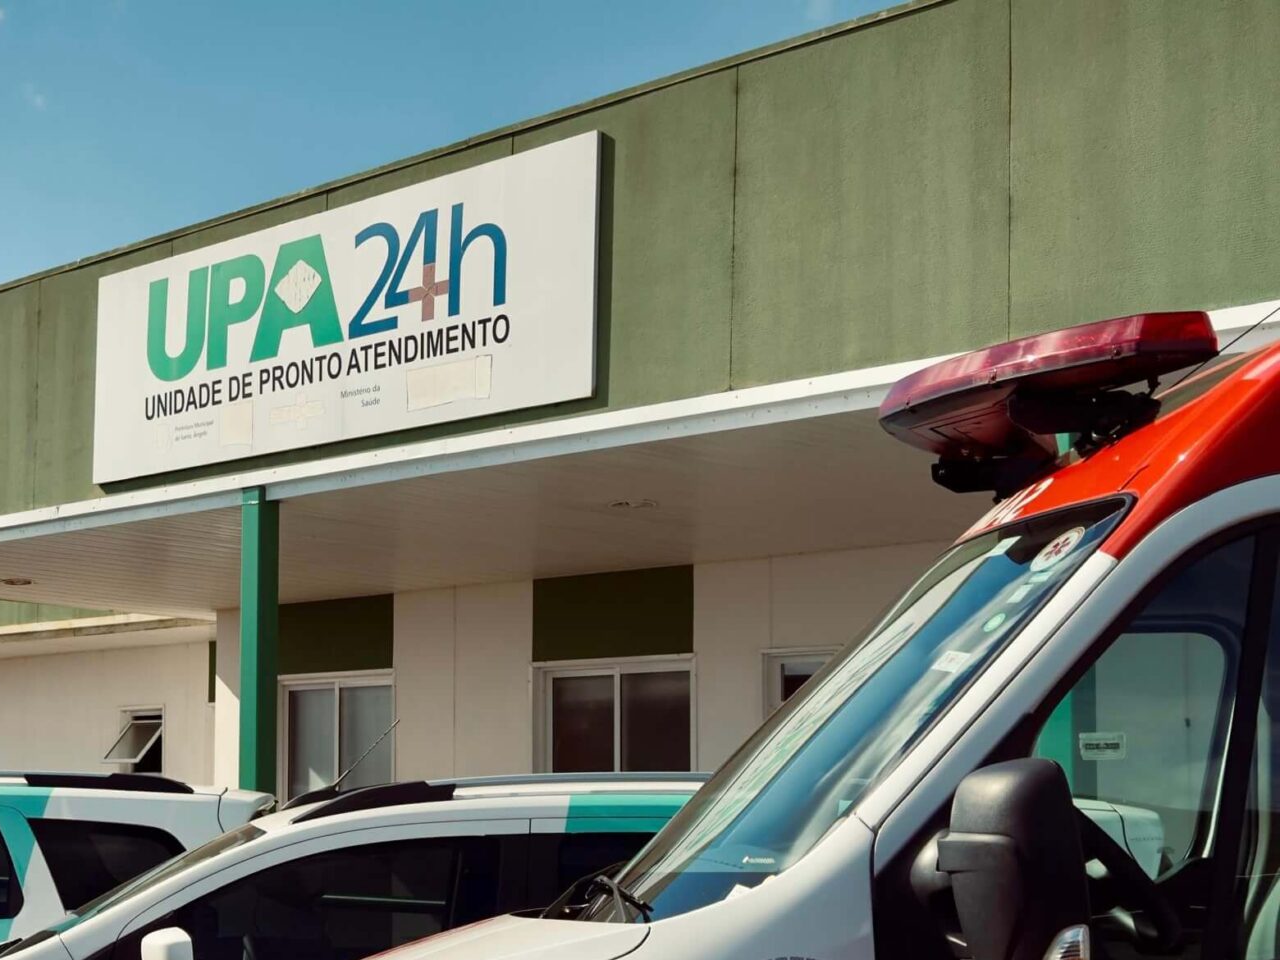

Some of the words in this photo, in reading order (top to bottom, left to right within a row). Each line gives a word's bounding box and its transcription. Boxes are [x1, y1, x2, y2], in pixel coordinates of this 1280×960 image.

[146, 234, 344, 382] UPA
[348, 202, 507, 340] 24h
[145, 379, 222, 420] UNIDADE
[228, 372, 253, 402] DE
[259, 352, 342, 395] PRONTO
[347, 314, 510, 376] ATENDIMENTO
[372, 384, 381, 392] da
